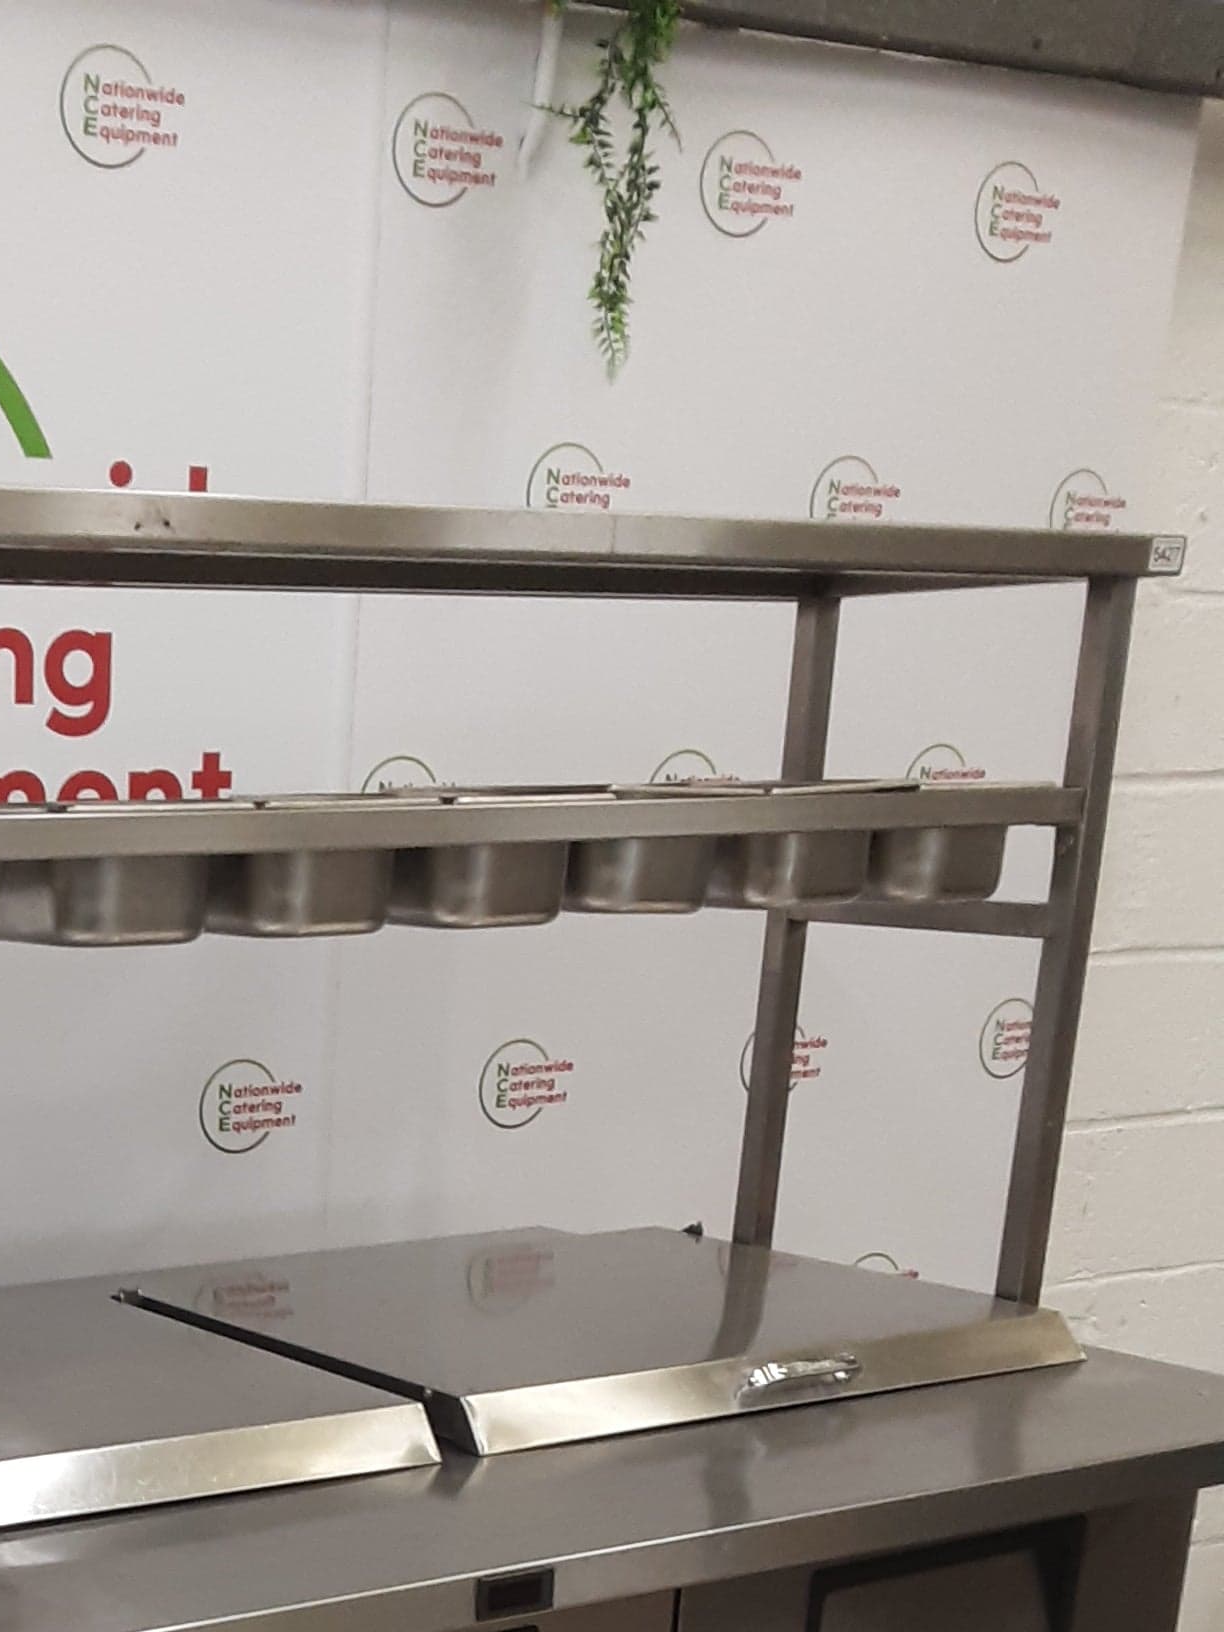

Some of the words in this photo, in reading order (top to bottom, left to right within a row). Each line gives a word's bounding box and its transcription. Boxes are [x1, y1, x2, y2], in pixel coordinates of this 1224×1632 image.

[84, 73, 185, 105] Nationwide
[84, 96, 160, 127] Catering
[83, 117, 178, 147] Equipment
[414, 121, 503, 148] Nationwide
[413, 140, 482, 168] Catering
[413, 160, 495, 187] Equipment
[720, 155, 801, 181] Nationwide
[720, 174, 781, 200] Catering
[719, 192, 793, 218] Equipment
[547, 468, 630, 488] Nationwide
[828, 479, 900, 498] Nationwide
[546, 486, 610, 509] Catering
[827, 497, 882, 517] Catering
[497, 1060, 574, 1078] Nationwide
[219, 1082, 302, 1098] Nationwide
[497, 1076, 554, 1093] Catering
[219, 1098, 282, 1116] Catering
[496, 1091, 566, 1109] Equipment
[218, 1114, 295, 1132] Equipment
